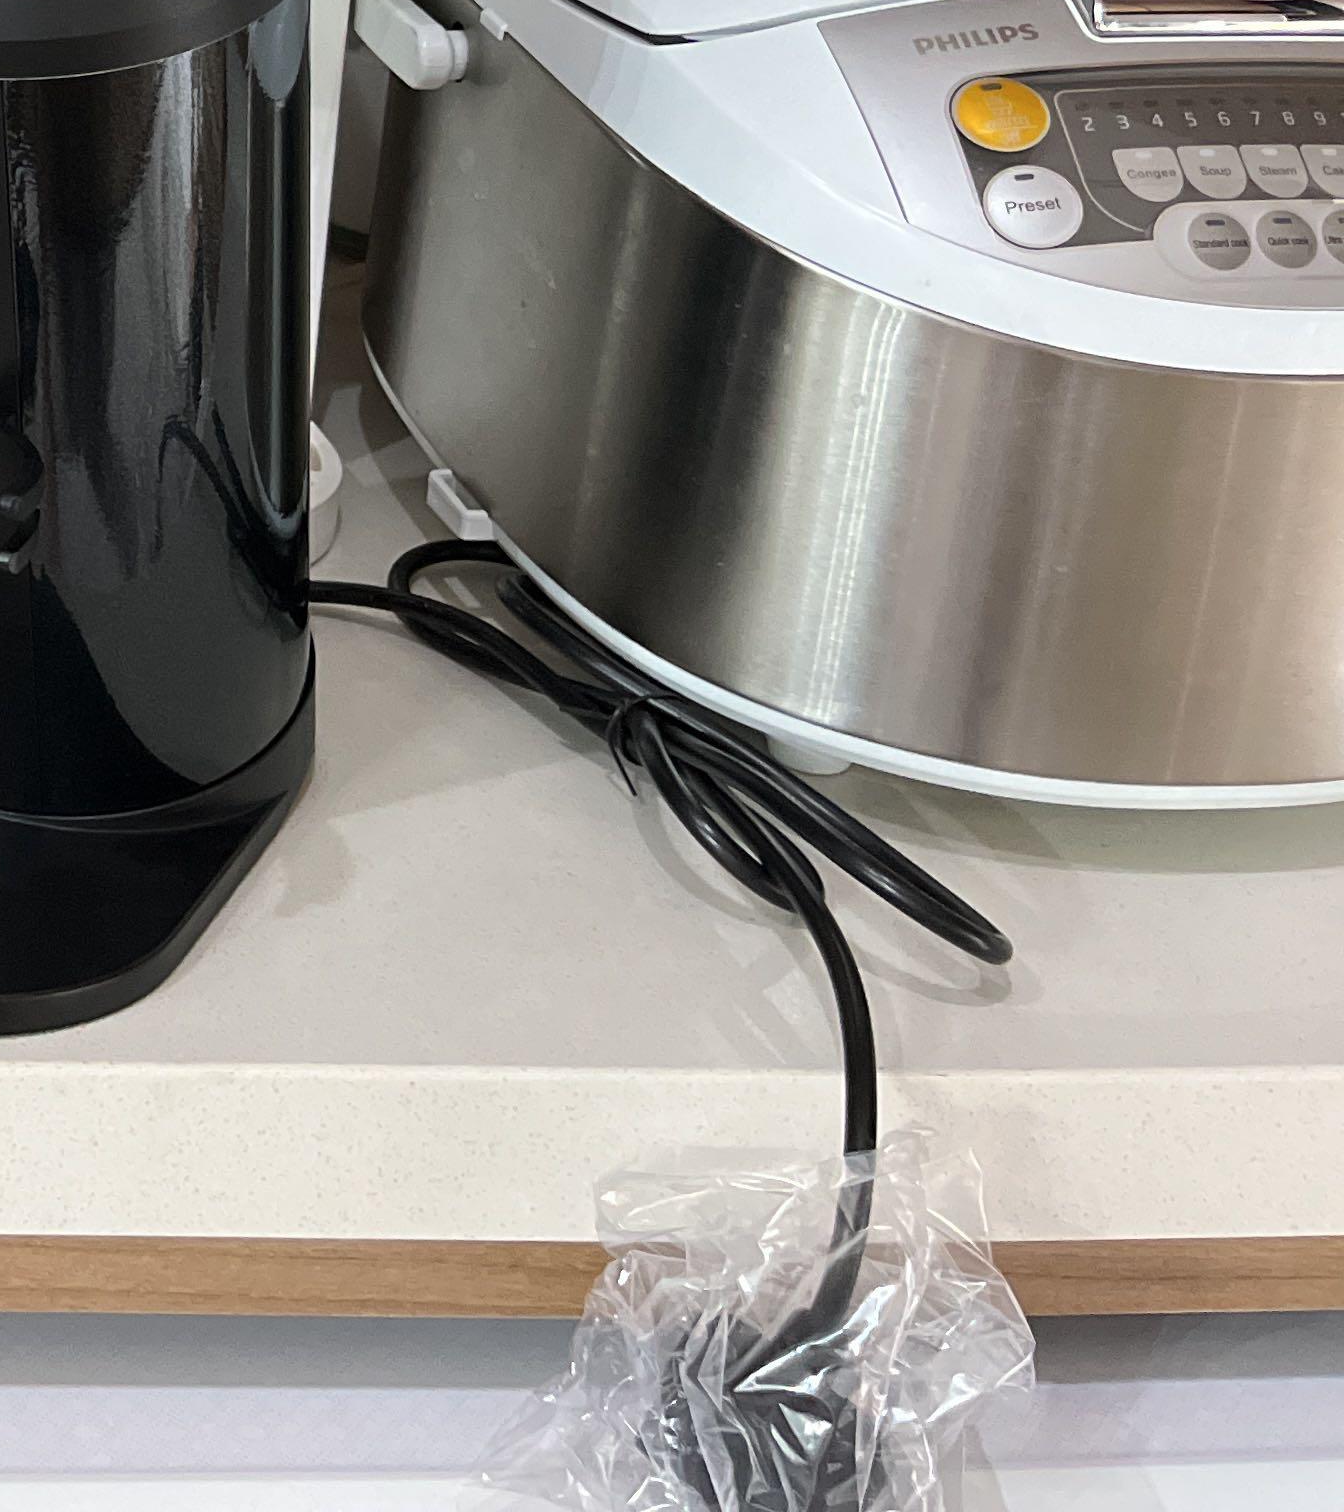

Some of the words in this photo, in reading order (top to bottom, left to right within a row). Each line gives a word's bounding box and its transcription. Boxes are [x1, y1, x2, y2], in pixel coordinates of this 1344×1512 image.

[912, 22, 1040, 56] PHILIPS
[1081, 116, 1095, 132] 2
[1116, 115, 1130, 130] 3
[1152, 112, 1164, 128] 4
[1184, 111, 1198, 128] 5
[1217, 111, 1231, 127] 6
[1249, 111, 1260, 126] 7
[1282, 111, 1295, 126] 8
[1313, 110, 1327, 126] 9
[1127, 167, 1177, 180] Congee
[1199, 165, 1232, 178] Soup
[1258, 166, 1298, 177] Steam
[1004, 197, 1062, 215] Preset
